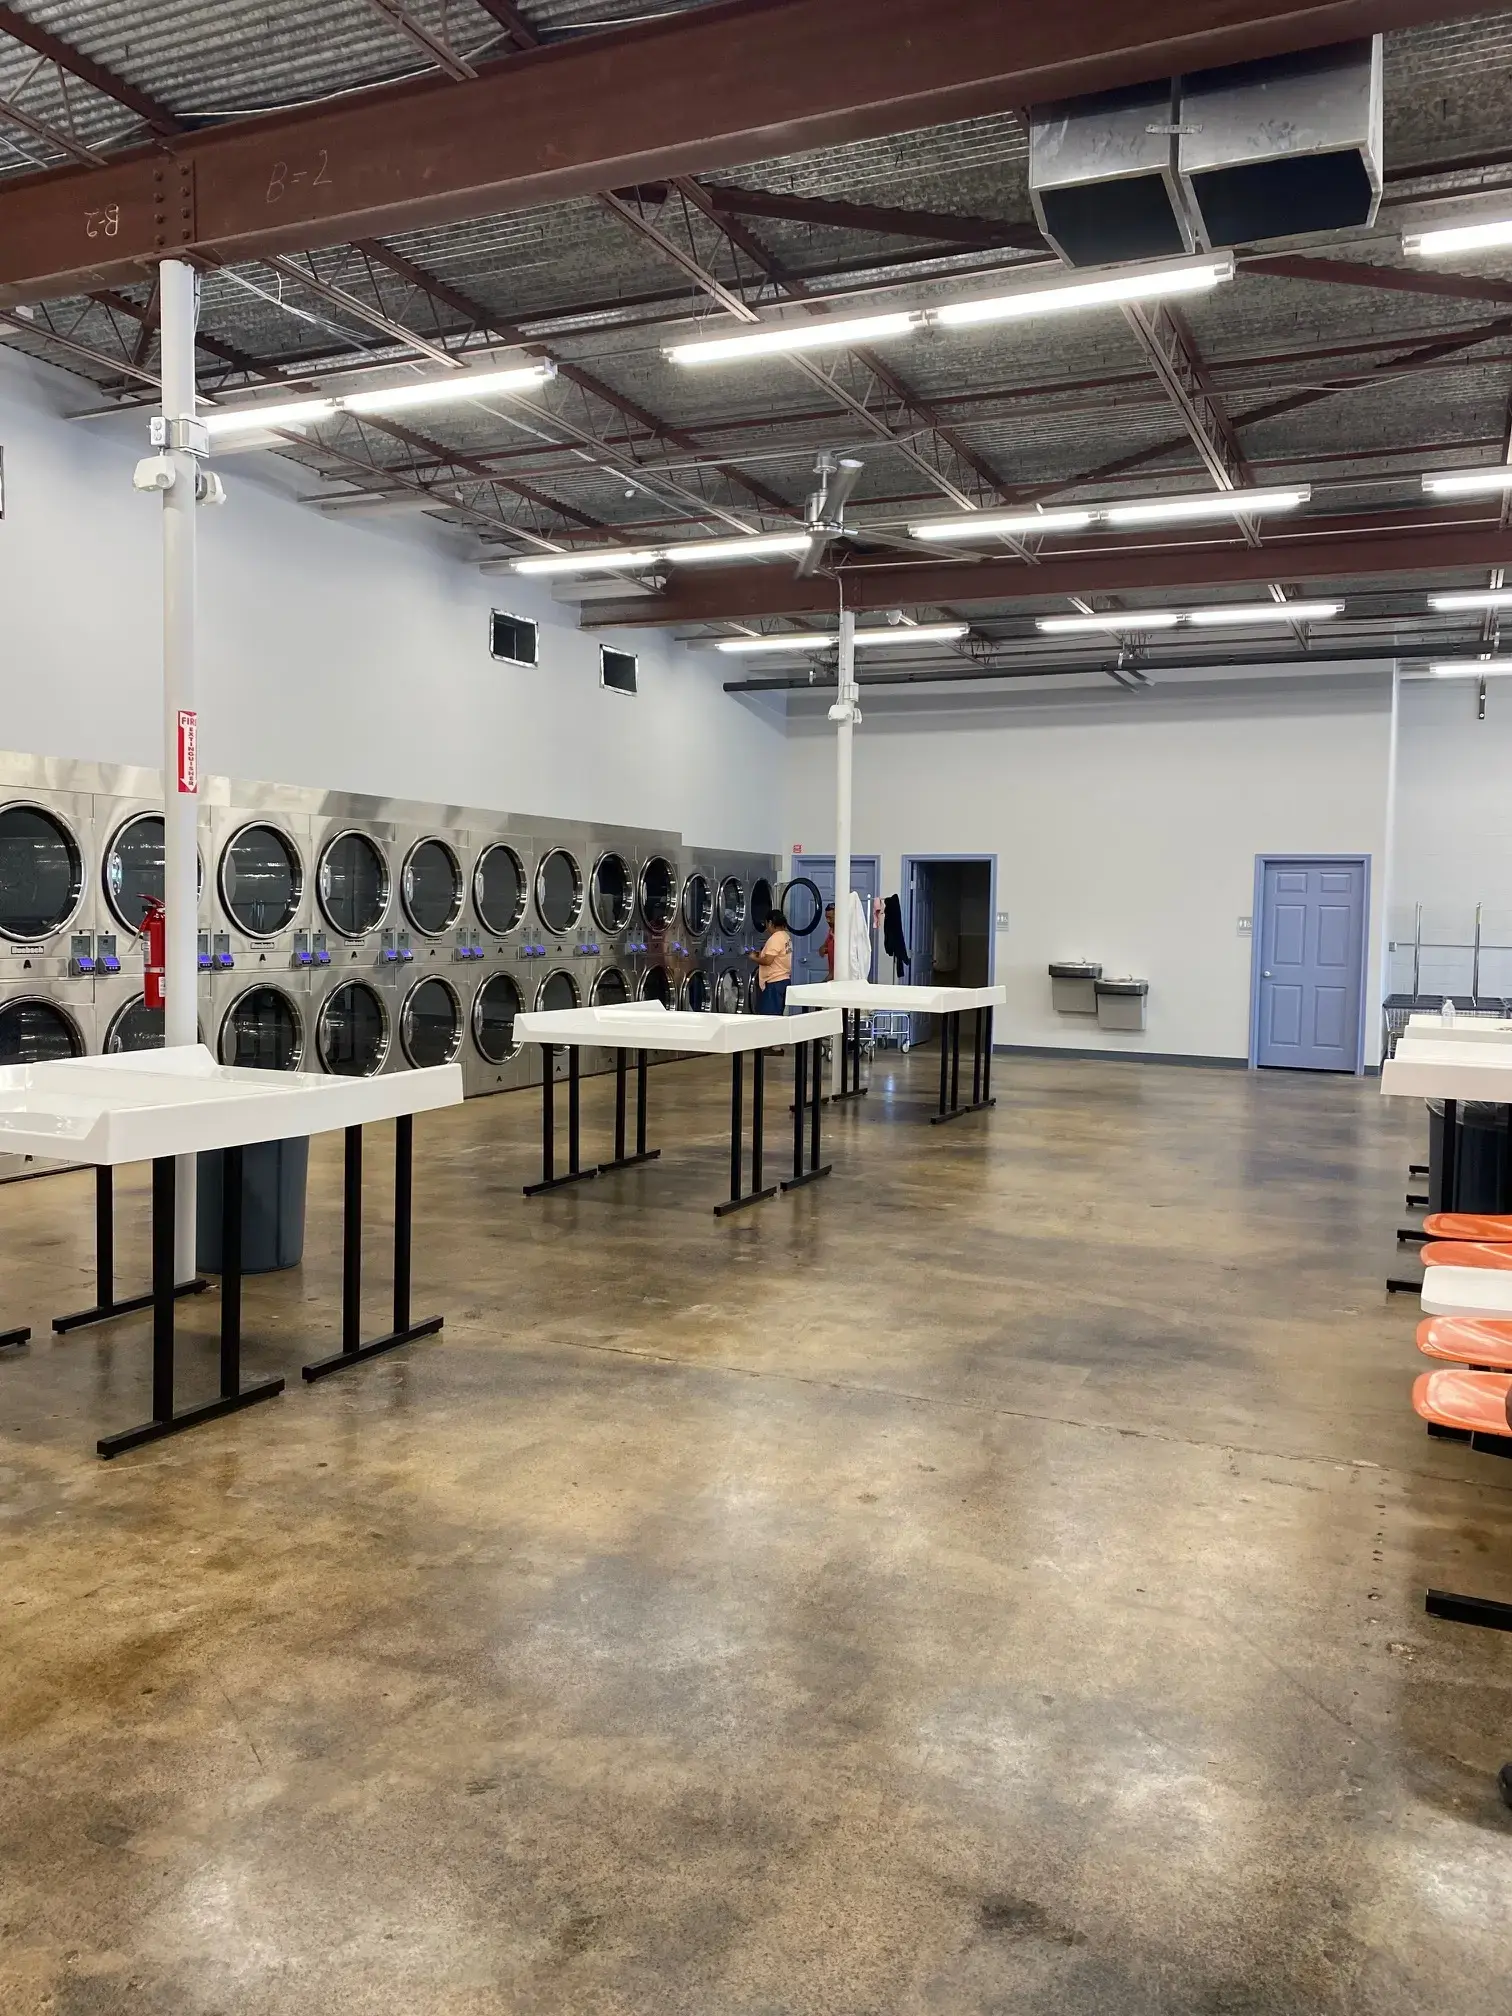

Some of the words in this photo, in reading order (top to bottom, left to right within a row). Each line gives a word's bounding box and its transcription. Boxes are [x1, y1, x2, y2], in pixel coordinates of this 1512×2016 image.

[84, 203, 119, 237] B-2
[187, 726, 195, 786] EXTINGUISHER
[23, 959, 32, 969] A
[259, 953, 267, 961] A
